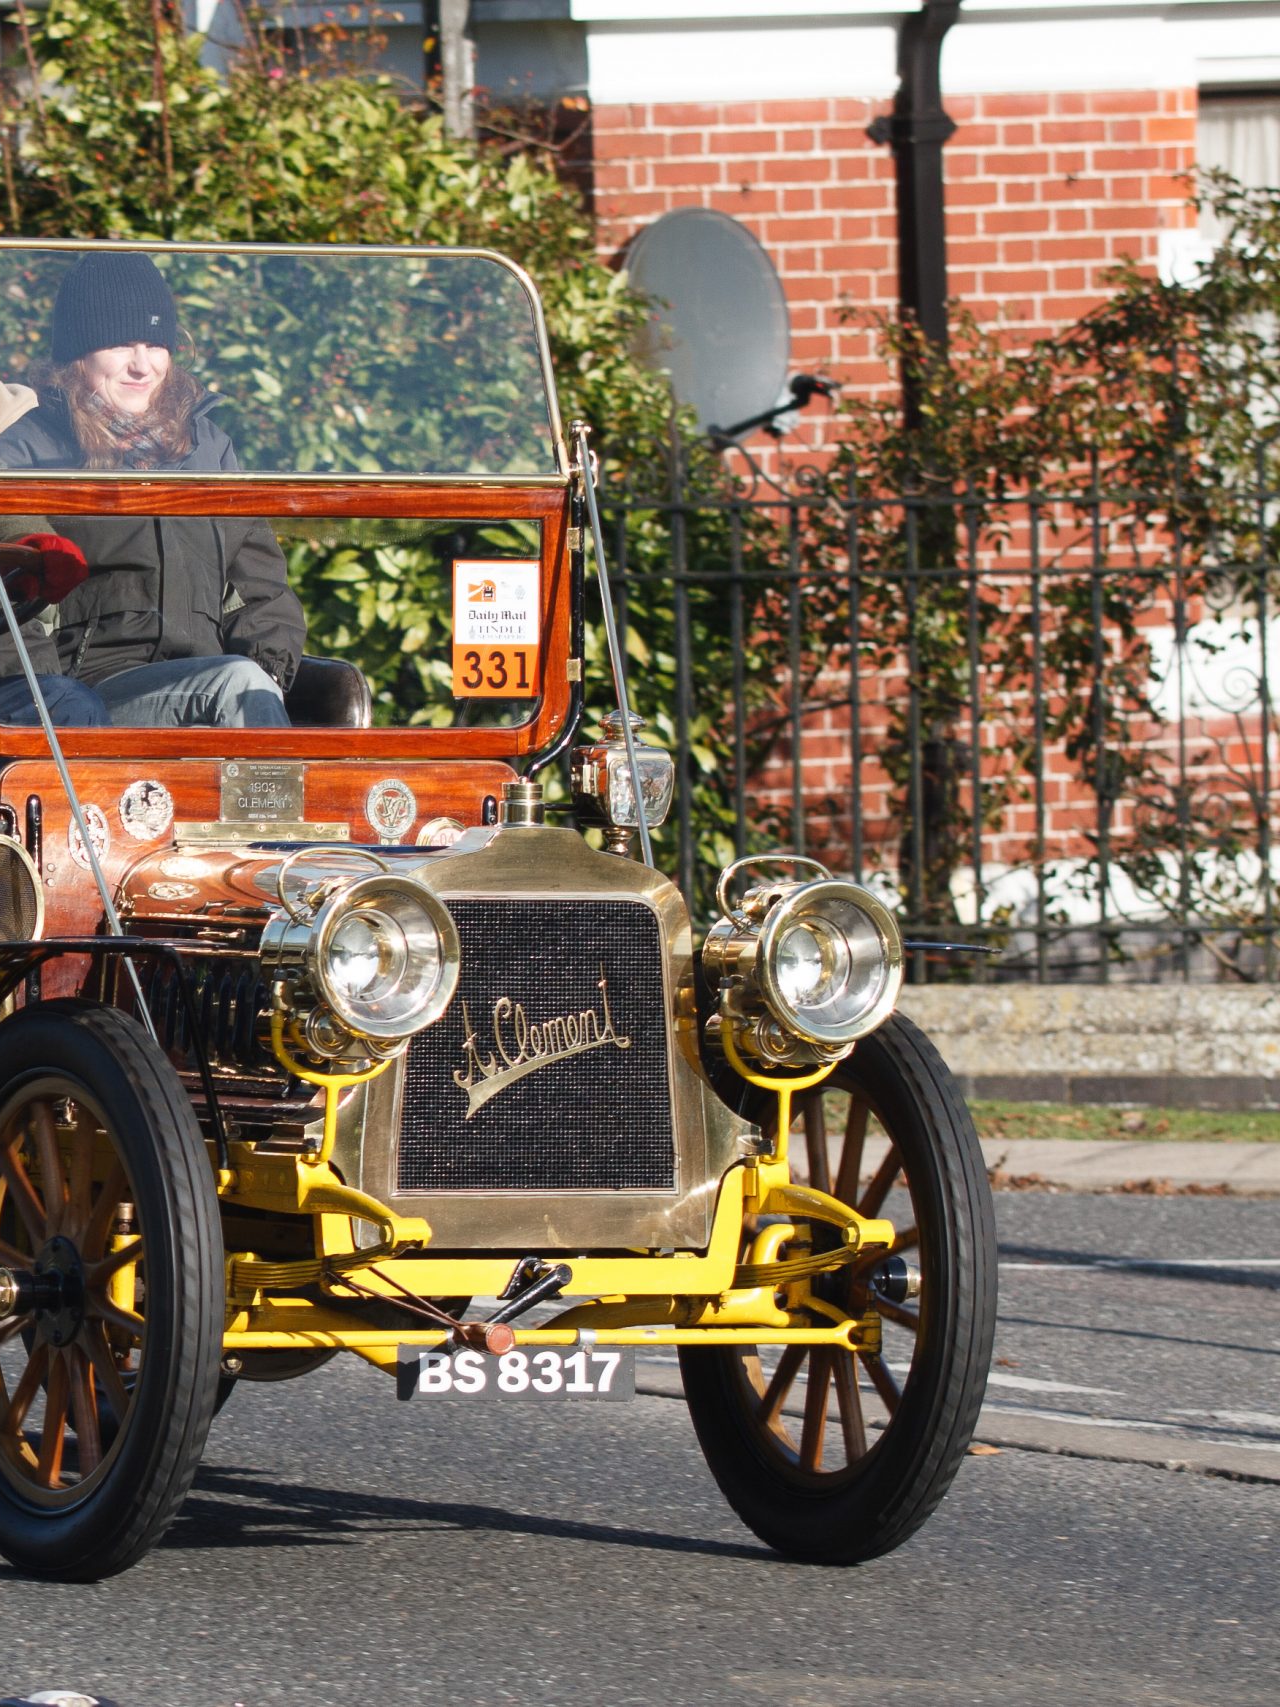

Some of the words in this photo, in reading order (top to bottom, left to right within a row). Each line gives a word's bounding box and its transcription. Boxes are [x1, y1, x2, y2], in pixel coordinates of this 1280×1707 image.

[468, 609, 498, 623] Daily
[501, 610, 527, 620] Mail
[462, 651, 529, 689] 331
[250, 782, 276, 793] 1903
[494, 961, 632, 1069] Clement
[418, 1351, 487, 1394] BS
[497, 1350, 621, 1394] 8317
